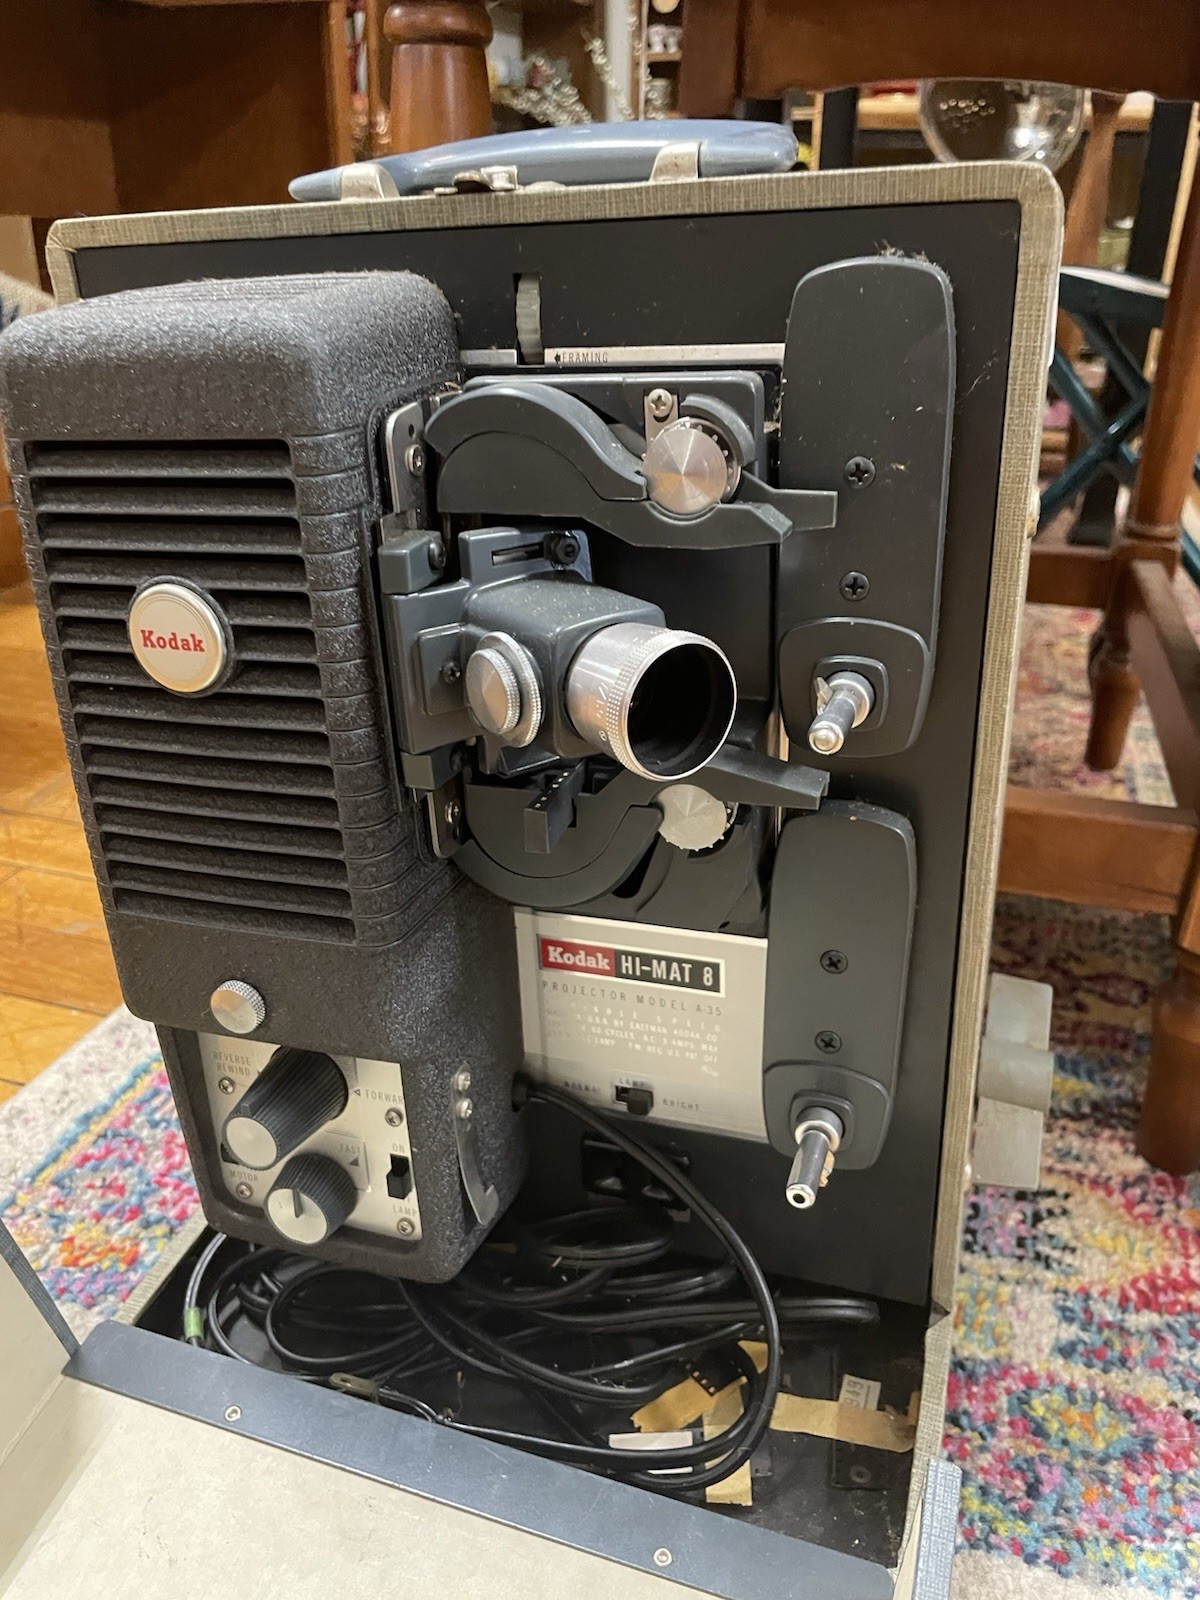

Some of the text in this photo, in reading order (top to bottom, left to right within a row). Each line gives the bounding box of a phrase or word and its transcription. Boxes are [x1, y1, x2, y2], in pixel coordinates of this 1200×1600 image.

[562, 352, 609, 364] FRAMING
[140, 629, 205, 652] Kodak
[547, 945, 714, 986] Kodak HI-MAT 8
[542, 981, 627, 1001] PROJECTOR
[636, 994, 687, 1012] MODEL
[604, 1027, 635, 1041] CYCLES
[629, 1021, 668, 1035] EASTMAN
[213, 1051, 251, 1067] REVERSE
[216, 1062, 251, 1076] REWIND
[365, 1089, 404, 1105] FORWAR
[662, 1098, 700, 1111] BRIGHT
[340, 1143, 361, 1154] FAST
[392, 1142, 405, 1154] ON
[229, 1169, 259, 1183] MOTOR
[393, 1204, 417, 1218] LAMP
